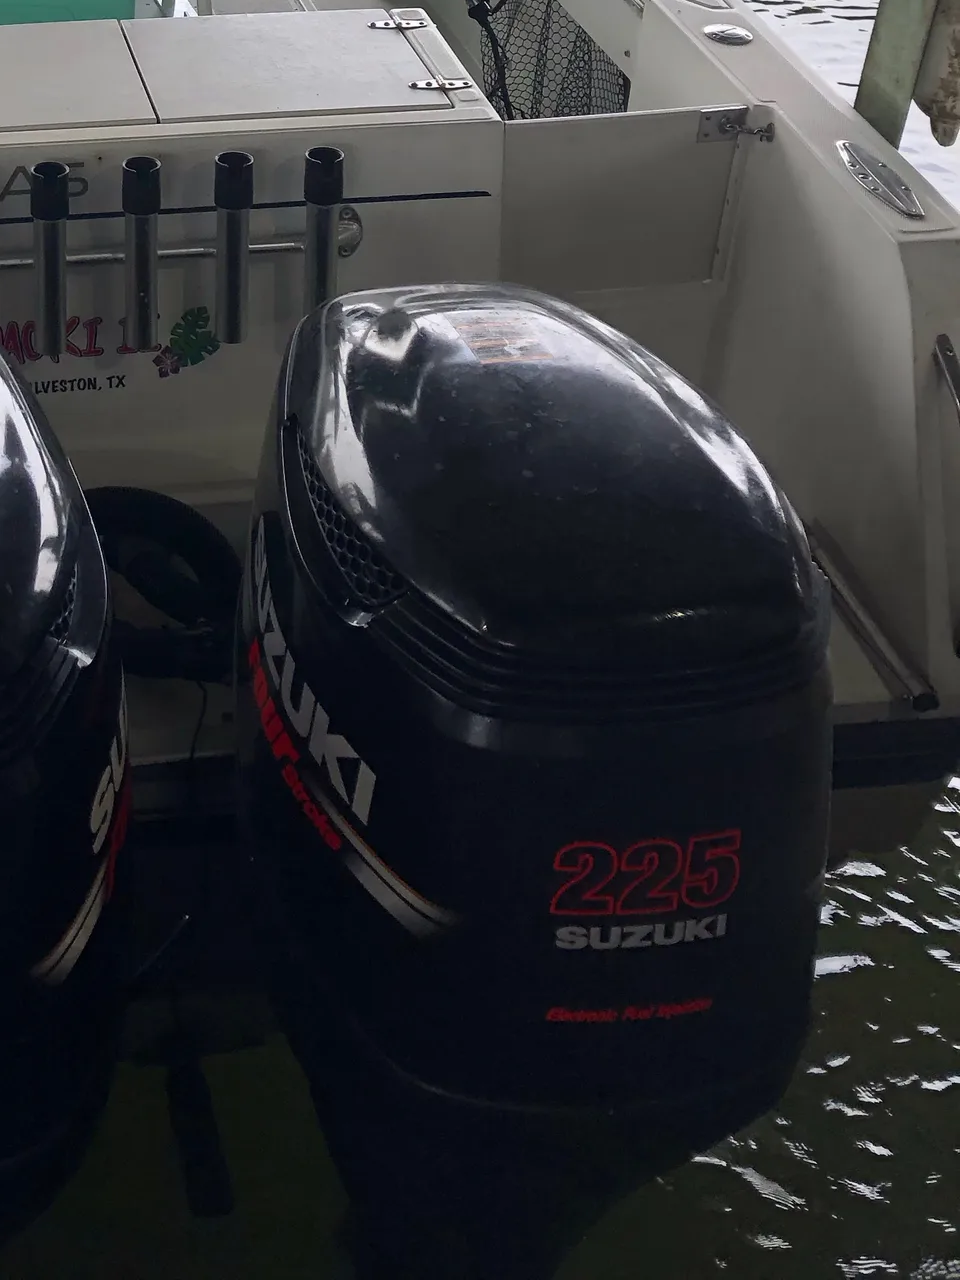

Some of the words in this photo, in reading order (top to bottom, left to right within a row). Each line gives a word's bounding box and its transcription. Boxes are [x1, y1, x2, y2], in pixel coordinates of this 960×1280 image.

[29, 376, 103, 395] LVESTON,
[106, 374, 126, 389] TX
[252, 515, 377, 826] SUZUKI
[549, 828, 742, 916] 225
[555, 913, 728, 950] SUZUKI
